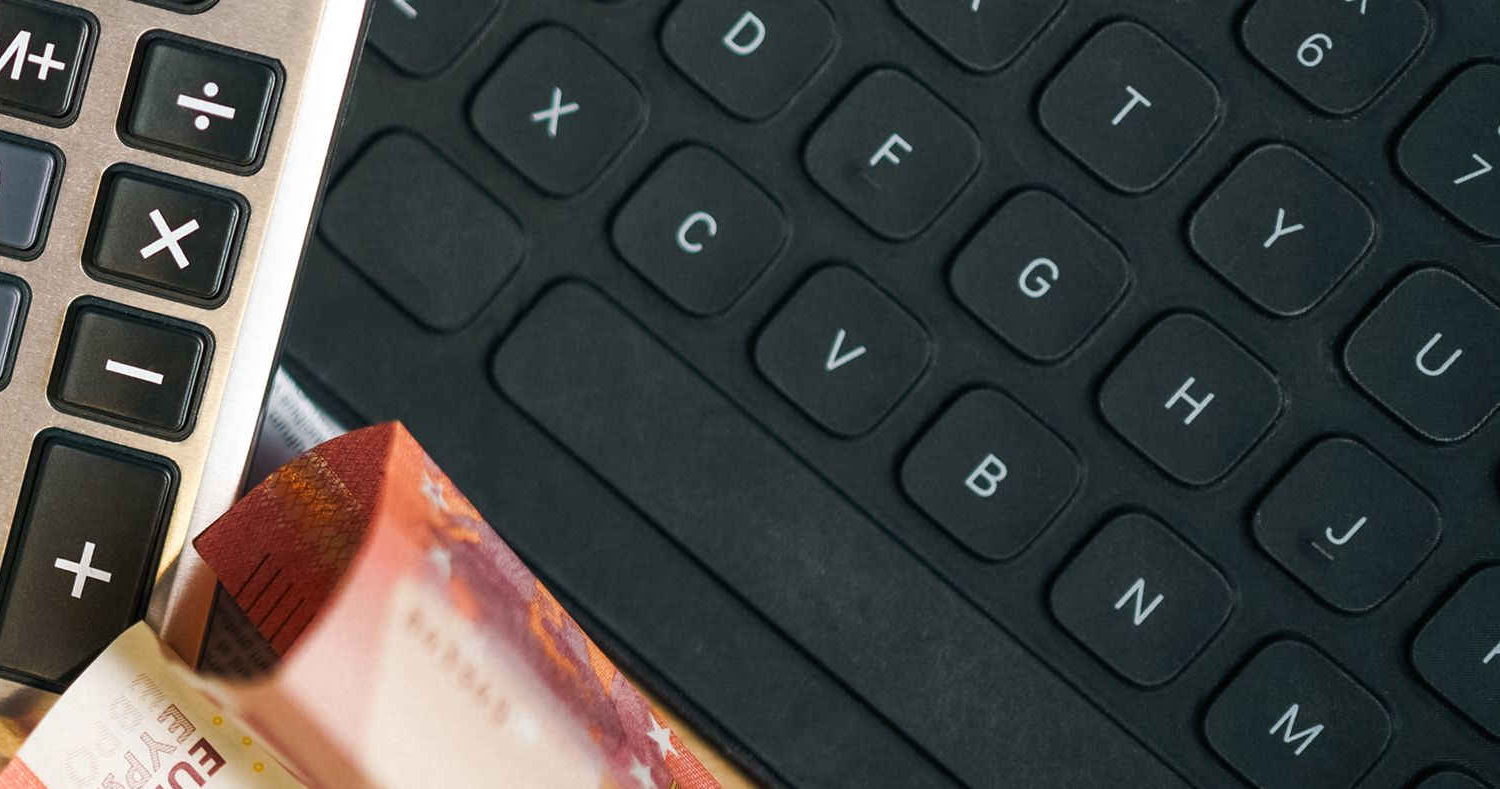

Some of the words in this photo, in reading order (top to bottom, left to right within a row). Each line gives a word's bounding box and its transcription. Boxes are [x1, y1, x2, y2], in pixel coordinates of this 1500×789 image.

[723, 11, 766, 55] D
[1297, 33, 1333, 67] 6
[531, 86, 579, 137] X
[1111, 85, 1152, 126] T
[869, 133, 913, 167] F
[1453, 153, 1493, 185] 7
[677, 212, 718, 253] C
[1263, 208, 1305, 248] Y
[1018, 257, 1059, 298] G
[826, 329, 867, 371] V
[1415, 332, 1463, 377] U
[1164, 376, 1215, 425] H
[964, 453, 1008, 497] B
[1325, 516, 1367, 546] J
[1114, 577, 1165, 626] N
[1269, 703, 1325, 756] M
[155, 737, 227, 789] EU
